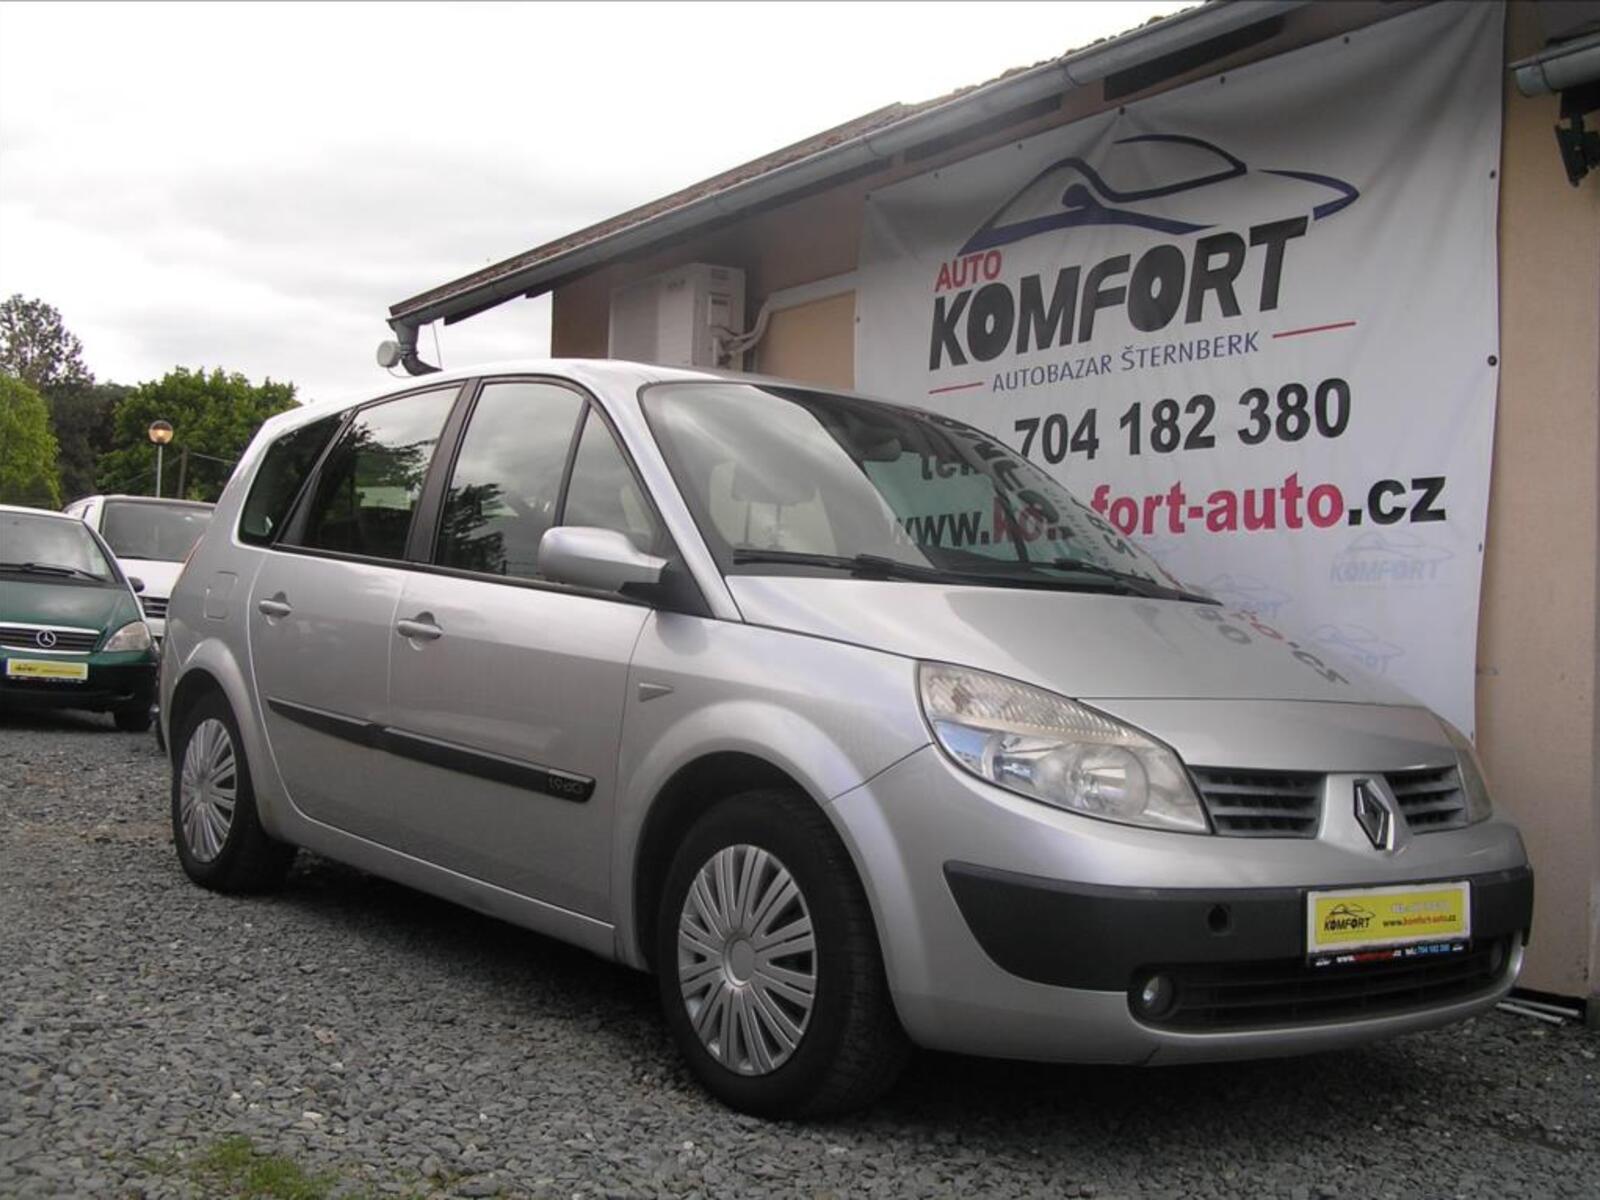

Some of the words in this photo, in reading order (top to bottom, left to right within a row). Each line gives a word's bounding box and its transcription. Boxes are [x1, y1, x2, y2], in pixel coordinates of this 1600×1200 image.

[929, 215, 1309, 371] KOMFORT
[935, 249, 1003, 292] AUTO
[992, 354, 1112, 393] AUTOBAZAR
[1121, 331, 1260, 371] ŠTERNBERK
[1014, 408, 1100, 465] 704
[1119, 394, 1216, 456] 182
[1237, 378, 1352, 445] 380
[1323, 917, 1371, 932] KOMFORT
